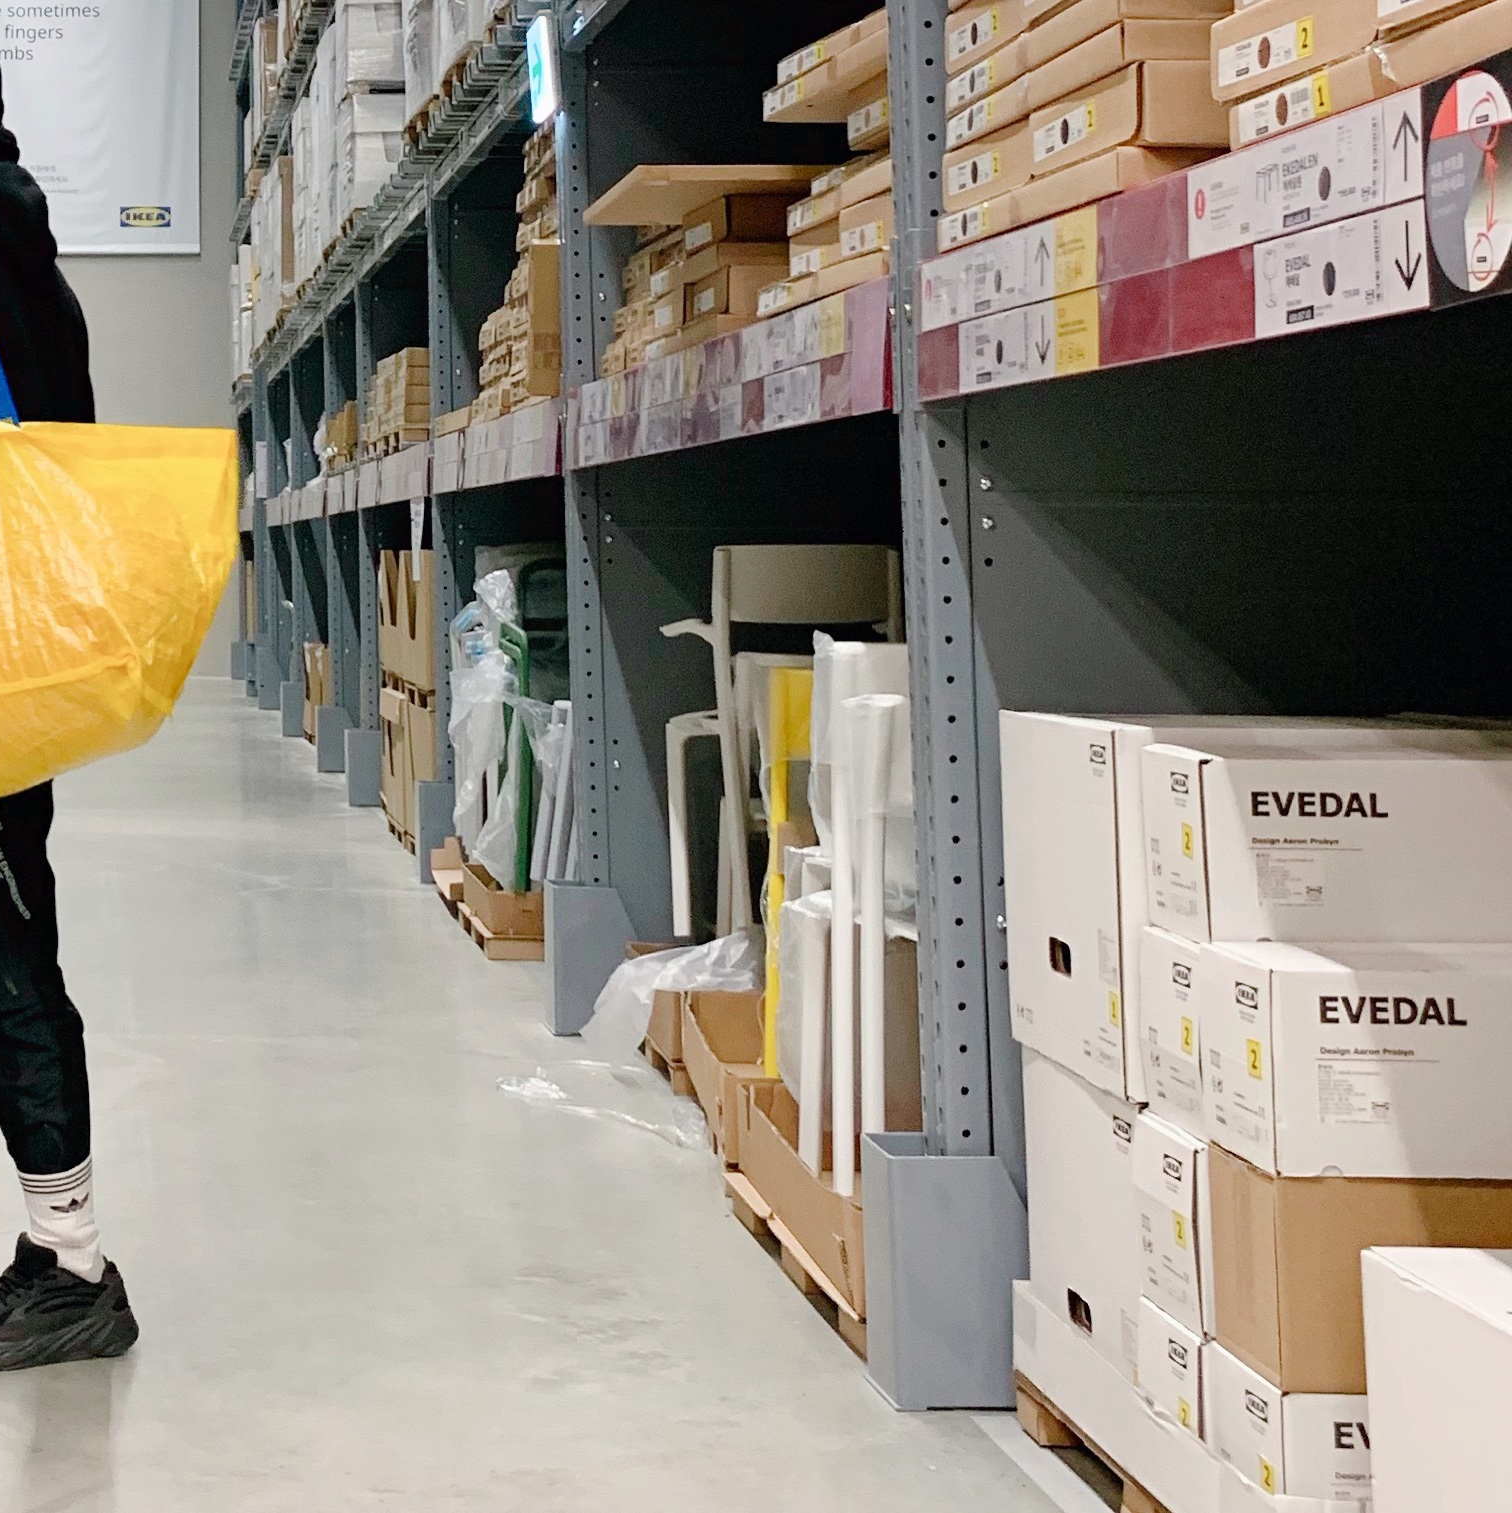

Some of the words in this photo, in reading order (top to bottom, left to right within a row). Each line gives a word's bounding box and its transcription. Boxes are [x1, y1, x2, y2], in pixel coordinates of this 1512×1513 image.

[7, 3, 101, 18] sometimes
[4, 24, 64, 43] fingers
[1301, 26, 1309, 50] 2
[1317, 86, 1325, 108] 1
[1251, 791, 1389, 818] EVEDAL
[1252, 837, 1281, 846] Design
[1319, 995, 1468, 1026] EVEDAL
[1184, 1025, 1190, 1047] 2
[1250, 1049, 1258, 1071] 2
[1320, 1046, 1351, 1057] Design
[1353, 1047, 1381, 1056] Aaron
[1263, 1464, 1272, 1488] 2
[1335, 1471, 1366, 1481] Design
